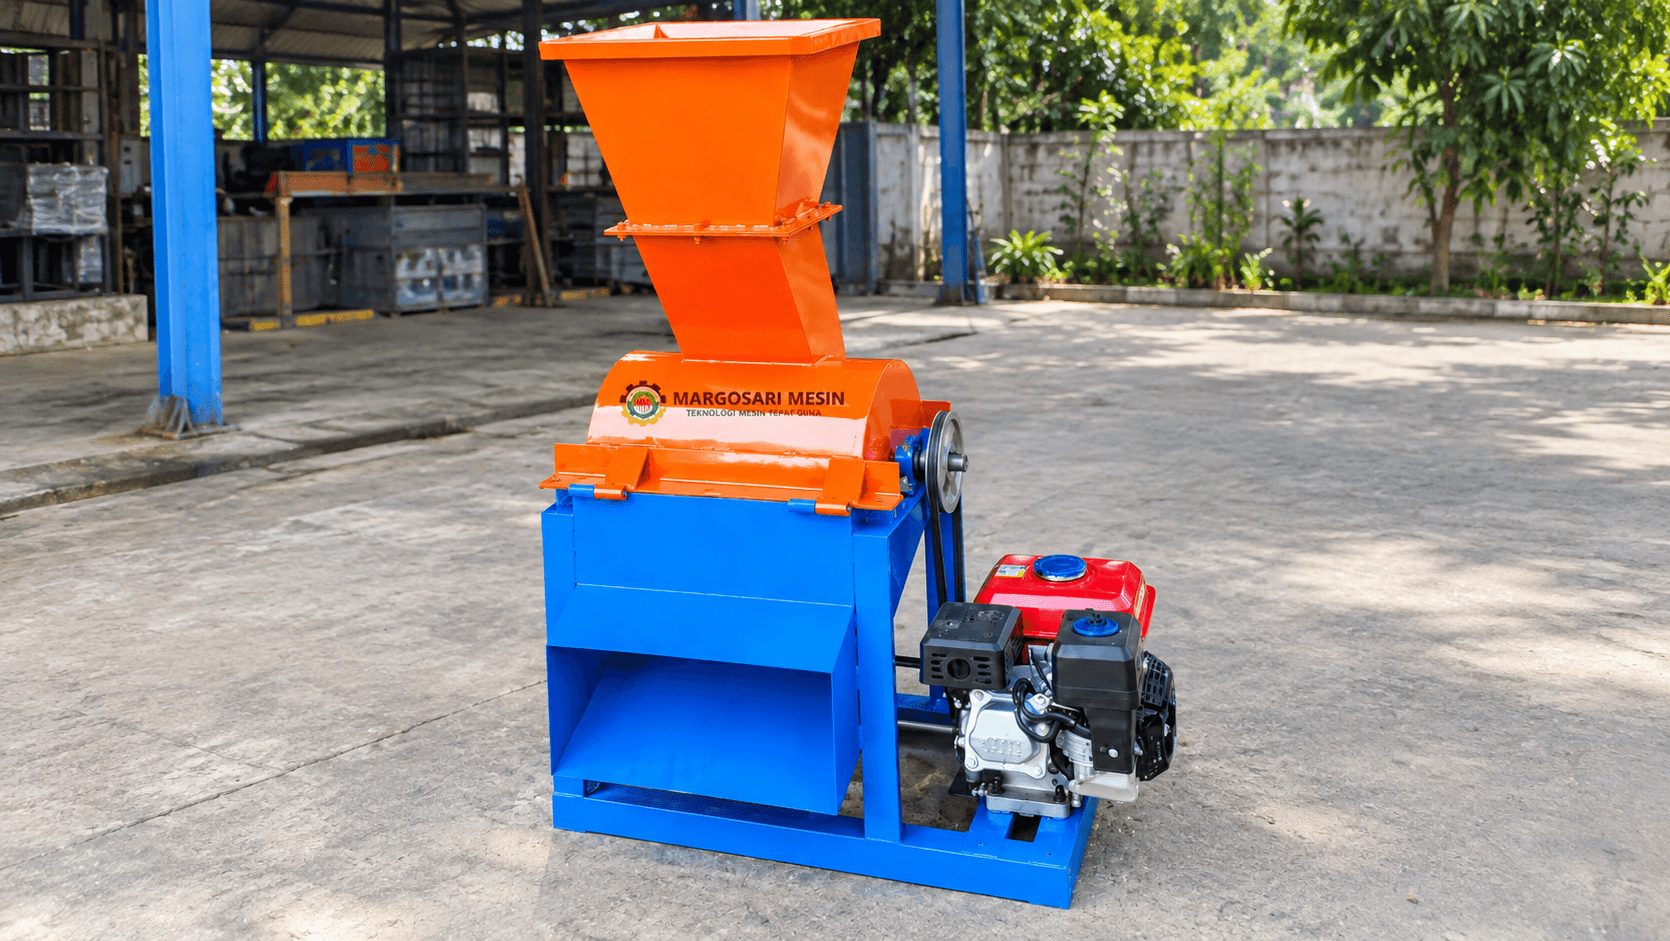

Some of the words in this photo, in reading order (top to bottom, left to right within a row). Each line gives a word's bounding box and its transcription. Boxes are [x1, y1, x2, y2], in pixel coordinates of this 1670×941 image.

[673, 391, 782, 406] MARGOSARI
[788, 391, 845, 406] MESIN
[686, 408, 736, 417] TEKNOLOGI
[738, 409, 766, 417] MESIN
[796, 409, 822, 417] GUNA
